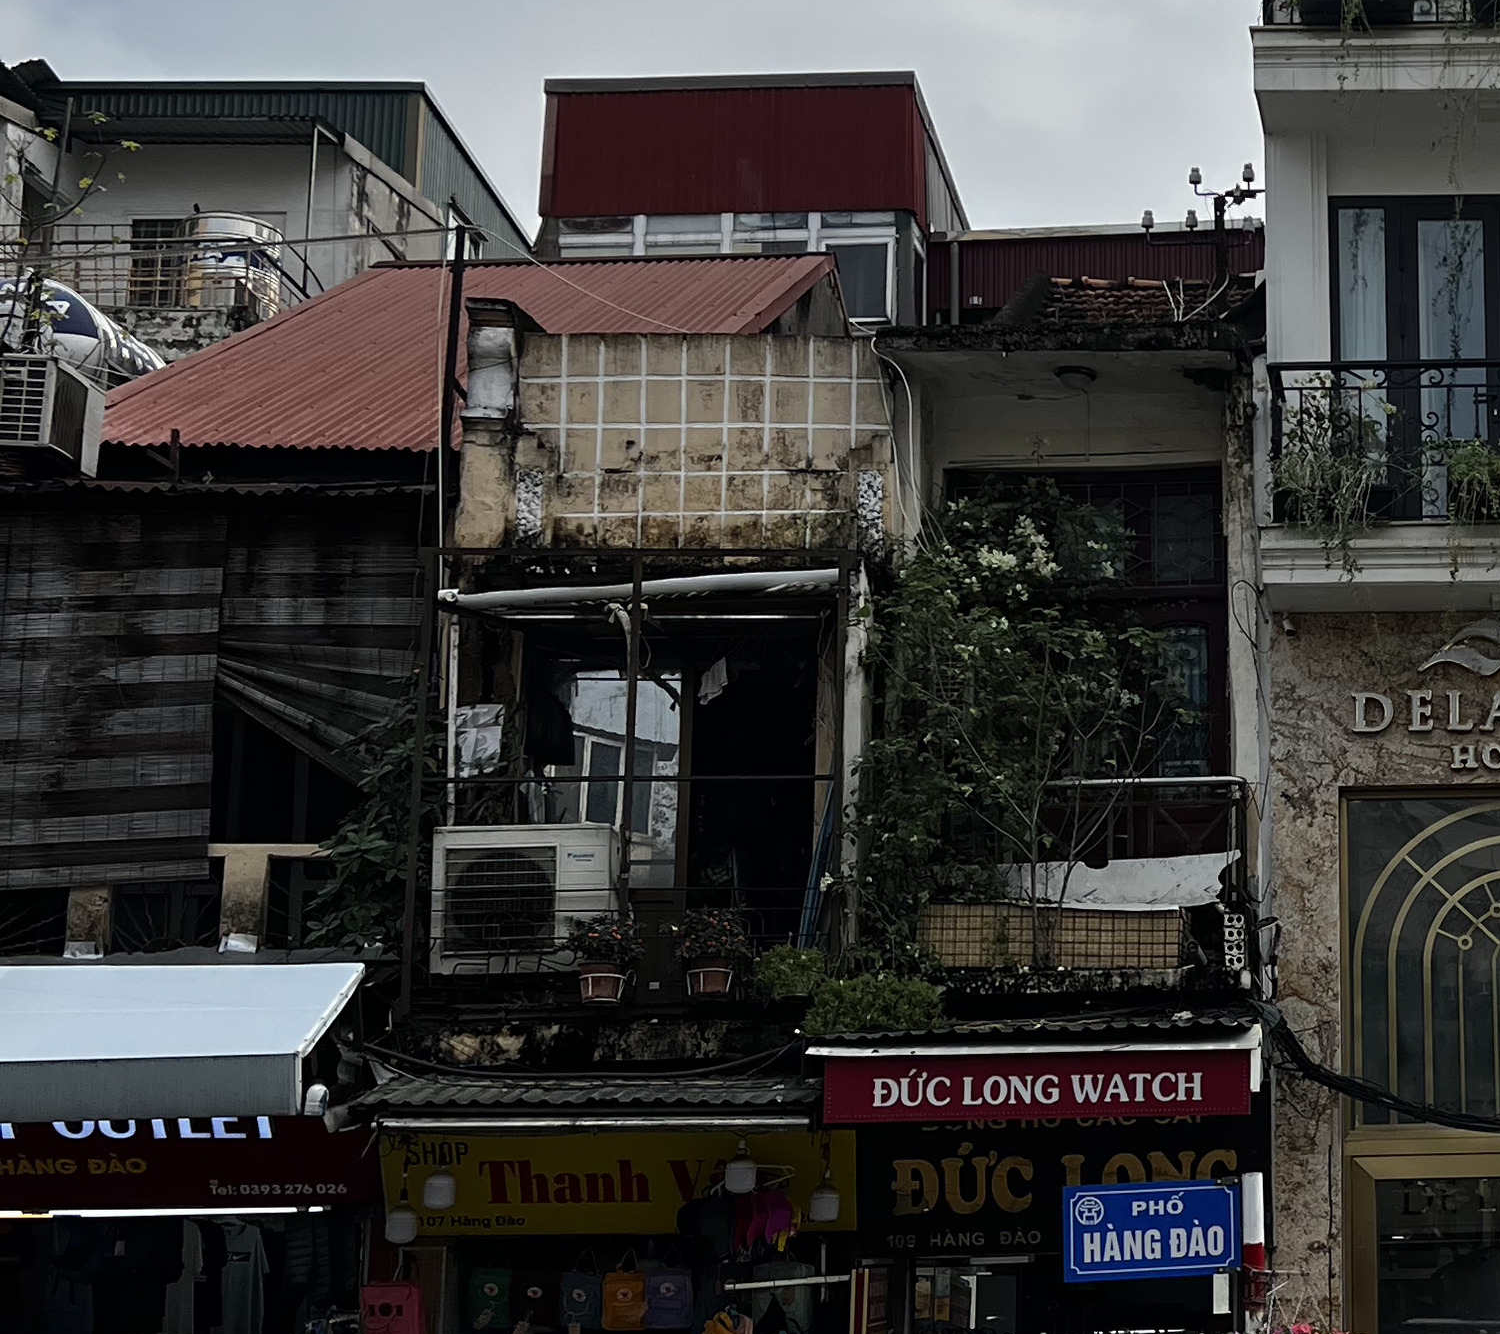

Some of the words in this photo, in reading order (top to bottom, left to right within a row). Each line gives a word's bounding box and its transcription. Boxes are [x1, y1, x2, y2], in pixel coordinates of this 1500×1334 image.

[872, 1068, 951, 1108] ĐỨC
[962, 1074, 1060, 1105] LONG
[1070, 1072, 1203, 1104] WATCH
[87, 1152, 148, 1176] ĐÀO
[405, 1142, 469, 1165] SHOP
[316, 1184, 348, 1195] 026
[478, 1159, 652, 1205] Thanh
[891, 1142, 1034, 1216] ĐỨC
[1131, 1192, 1186, 1217] PHỐ
[419, 1216, 445, 1227] 107
[451, 1213, 491, 1229] Hàng
[495, 1214, 527, 1227] Đào
[886, 1233, 917, 1250] 109
[929, 1228, 985, 1248] HÀNG
[999, 1225, 1042, 1245] ĐÀO
[1083, 1223, 1162, 1264] HÀNG
[1168, 1219, 1225, 1258] ĐÀO
